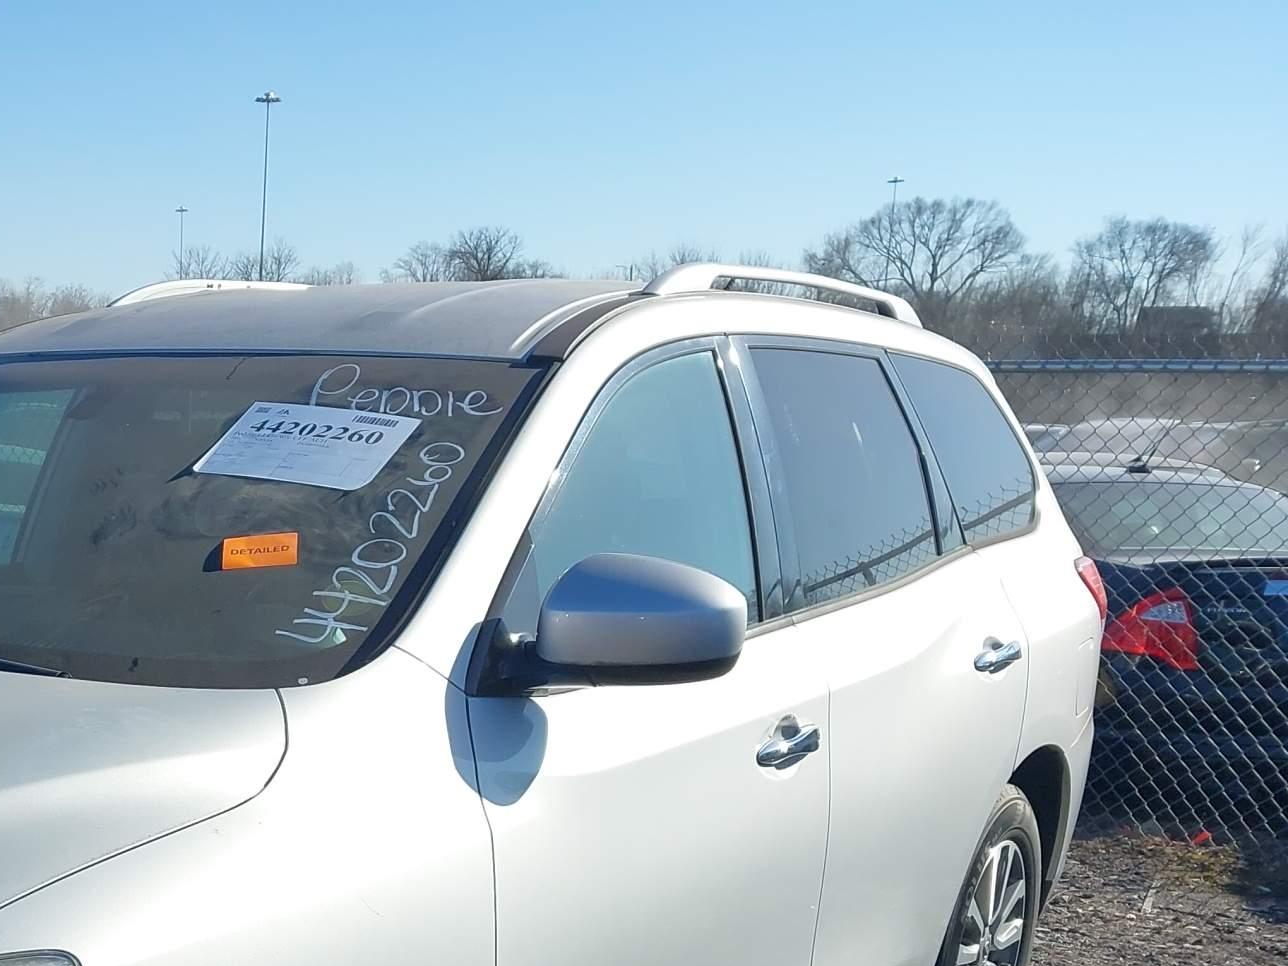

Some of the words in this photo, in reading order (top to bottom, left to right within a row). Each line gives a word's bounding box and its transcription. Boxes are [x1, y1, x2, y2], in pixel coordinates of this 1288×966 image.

[250, 419, 384, 445] 44202260
[230, 545, 290, 556] DETAILED
[274, 442, 465, 642] 44202260
